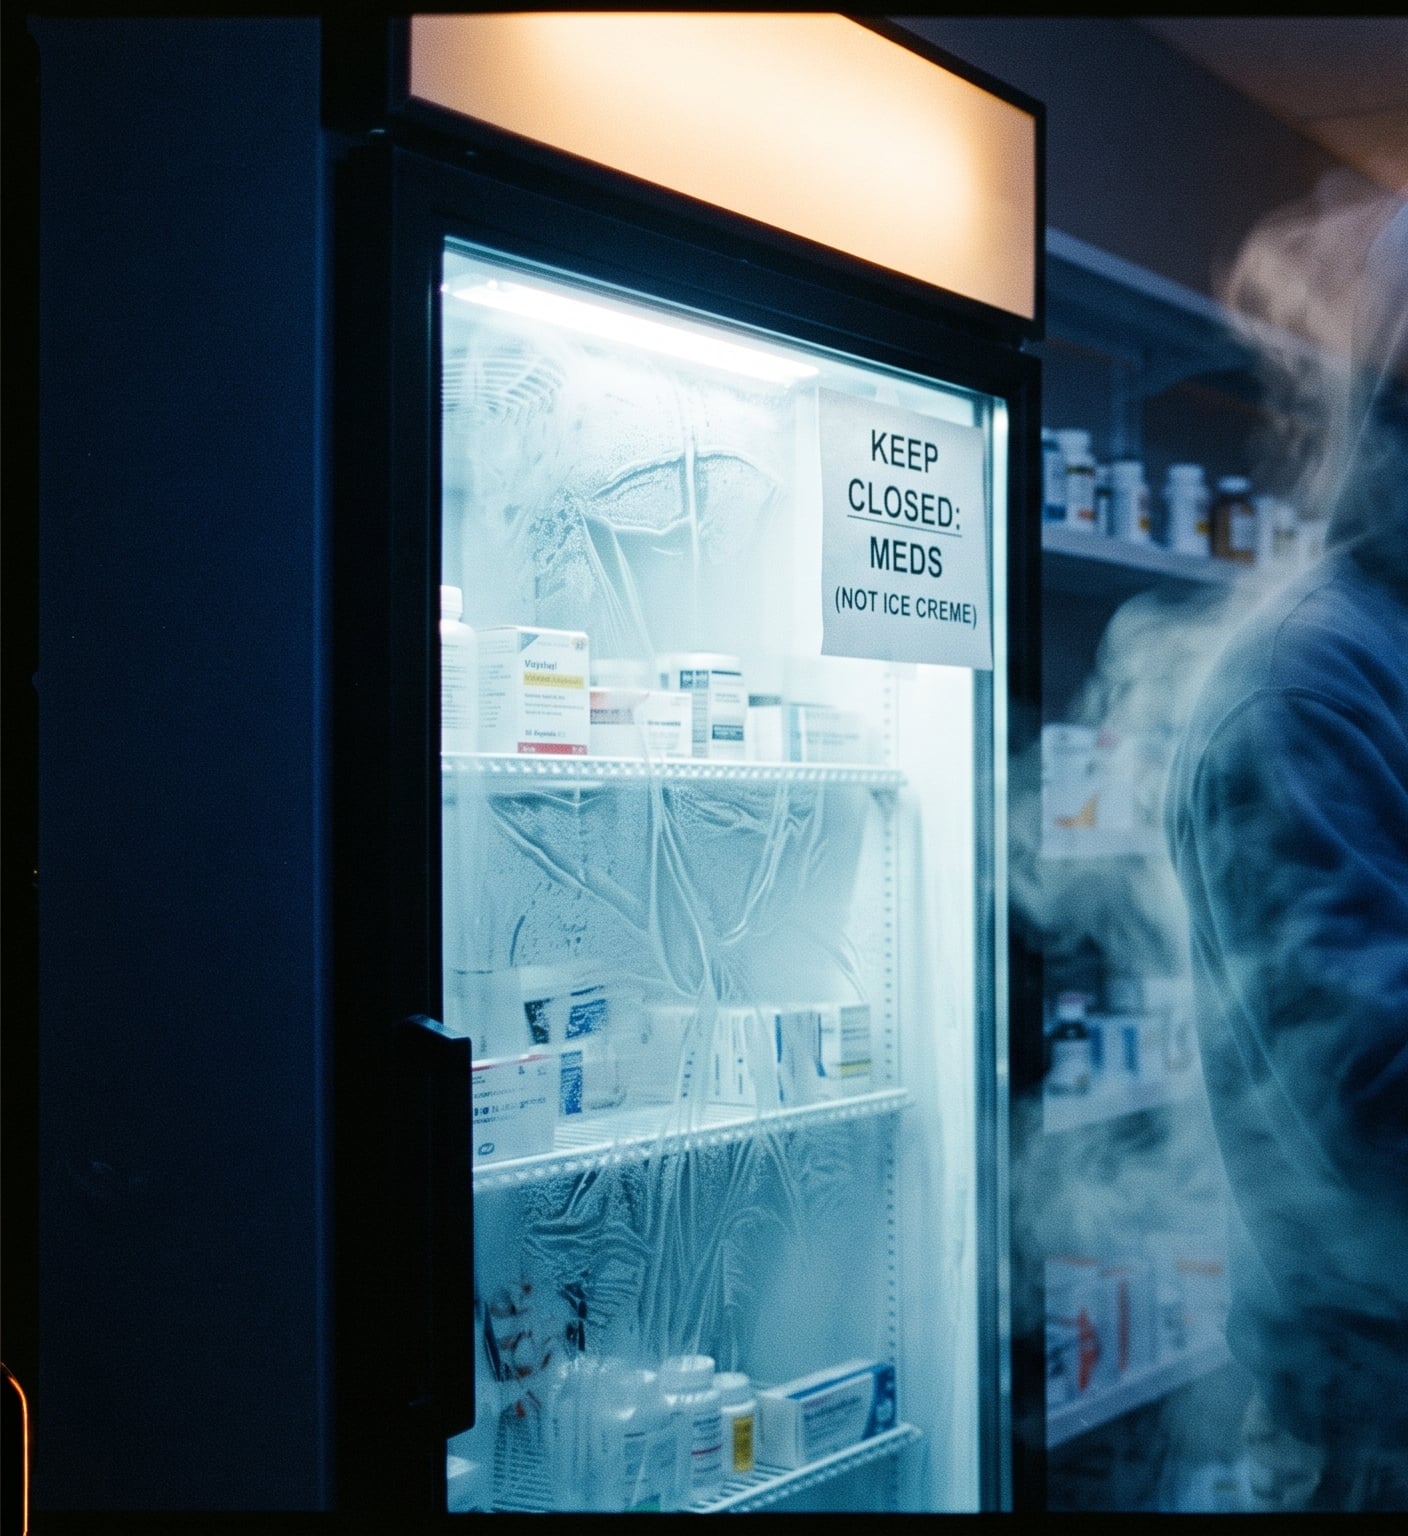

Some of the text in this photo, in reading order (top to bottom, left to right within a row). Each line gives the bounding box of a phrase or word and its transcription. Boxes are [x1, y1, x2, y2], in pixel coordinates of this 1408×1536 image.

[871, 429, 939, 473] KEEP
[848, 478, 961, 531] CLOSED:
[870, 536, 943, 578] MEDS
[835, 586, 977, 629] (NOT ICE CREME)
